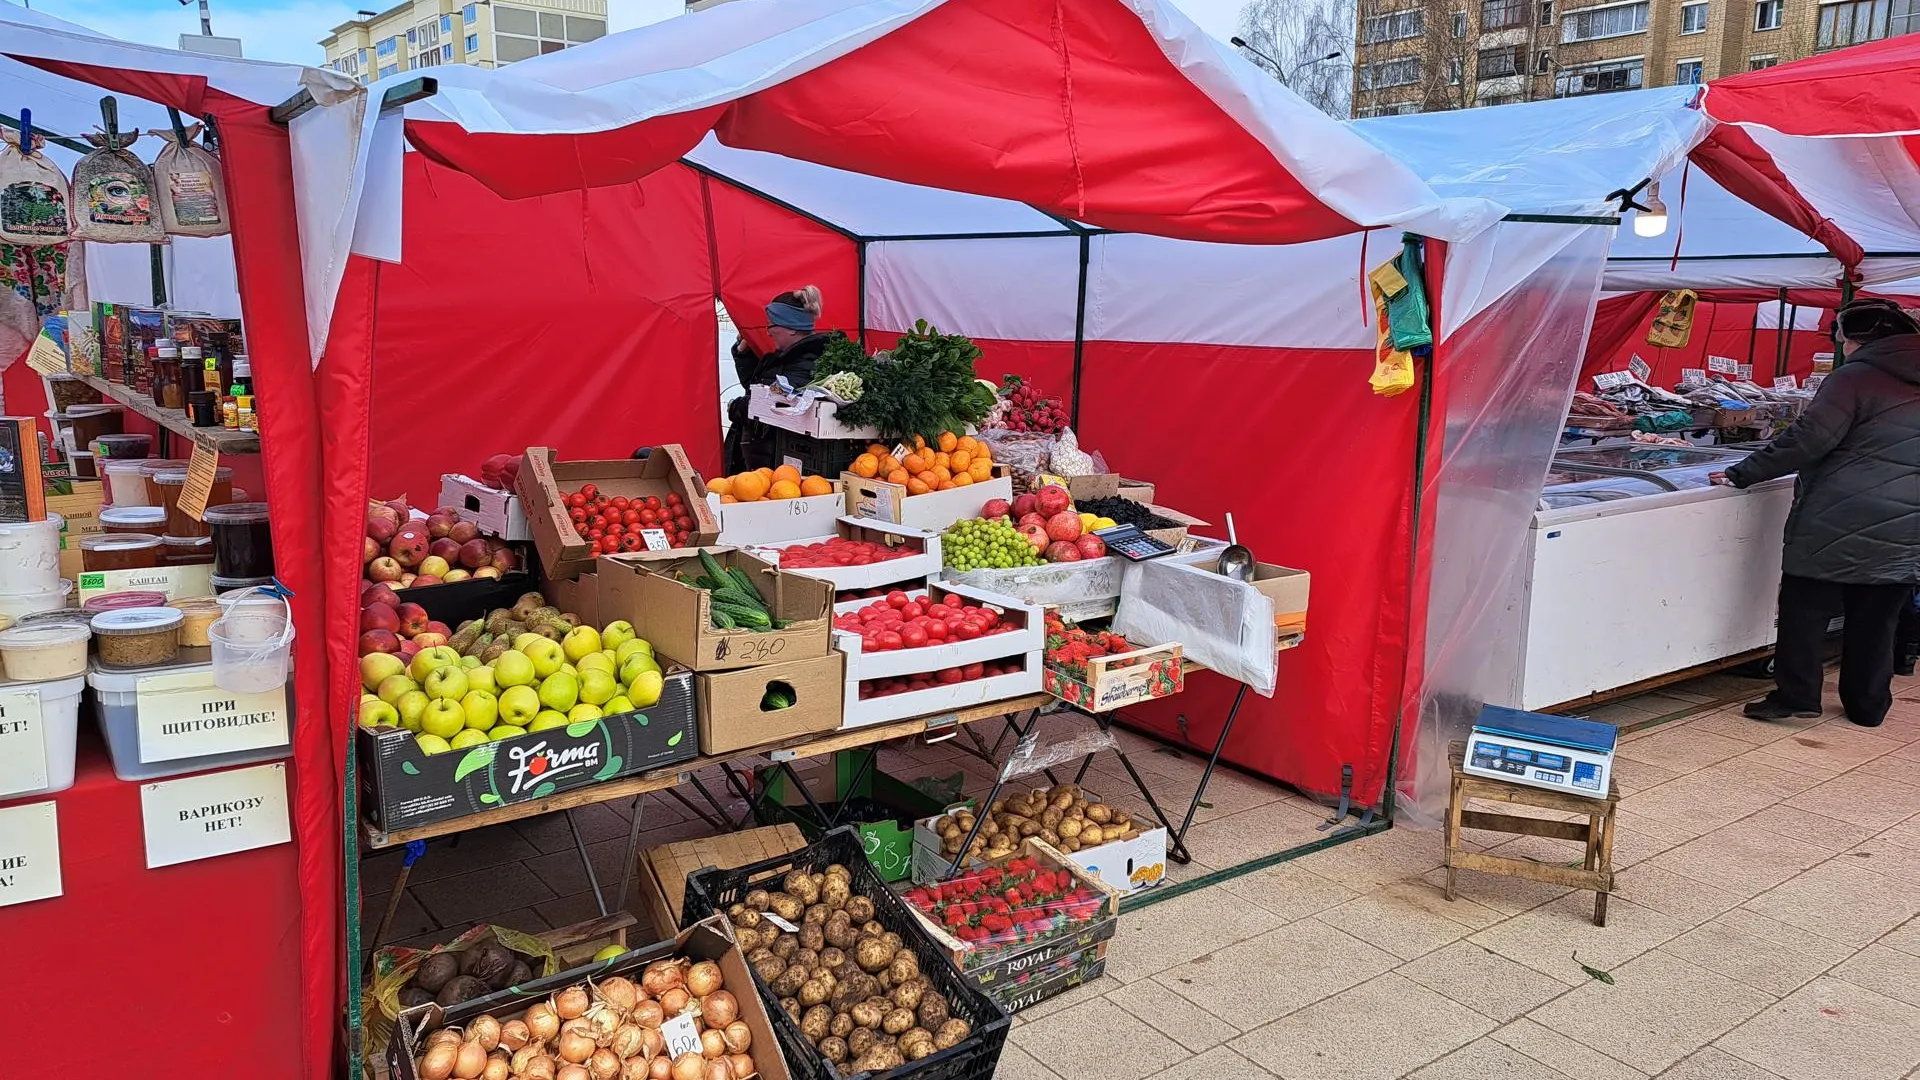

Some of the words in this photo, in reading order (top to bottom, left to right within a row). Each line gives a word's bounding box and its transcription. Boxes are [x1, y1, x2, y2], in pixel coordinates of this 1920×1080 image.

[788, 500, 808, 515] 180
[129, 576, 169, 586] КАШТАН
[739, 638, 786, 660] 280
[202, 700, 236, 714] ПРИ
[0, 720, 28, 735] ЕТ!
[162, 711, 276, 735] ЩИТОВИДКЕ!
[509, 741, 600, 794] Forma
[584, 758, 598, 767] BM
[179, 796, 264, 821] ВАРИКОЗУ
[205, 816, 242, 833] НЕТ!
[1007, 948, 1053, 975] ROYAL
